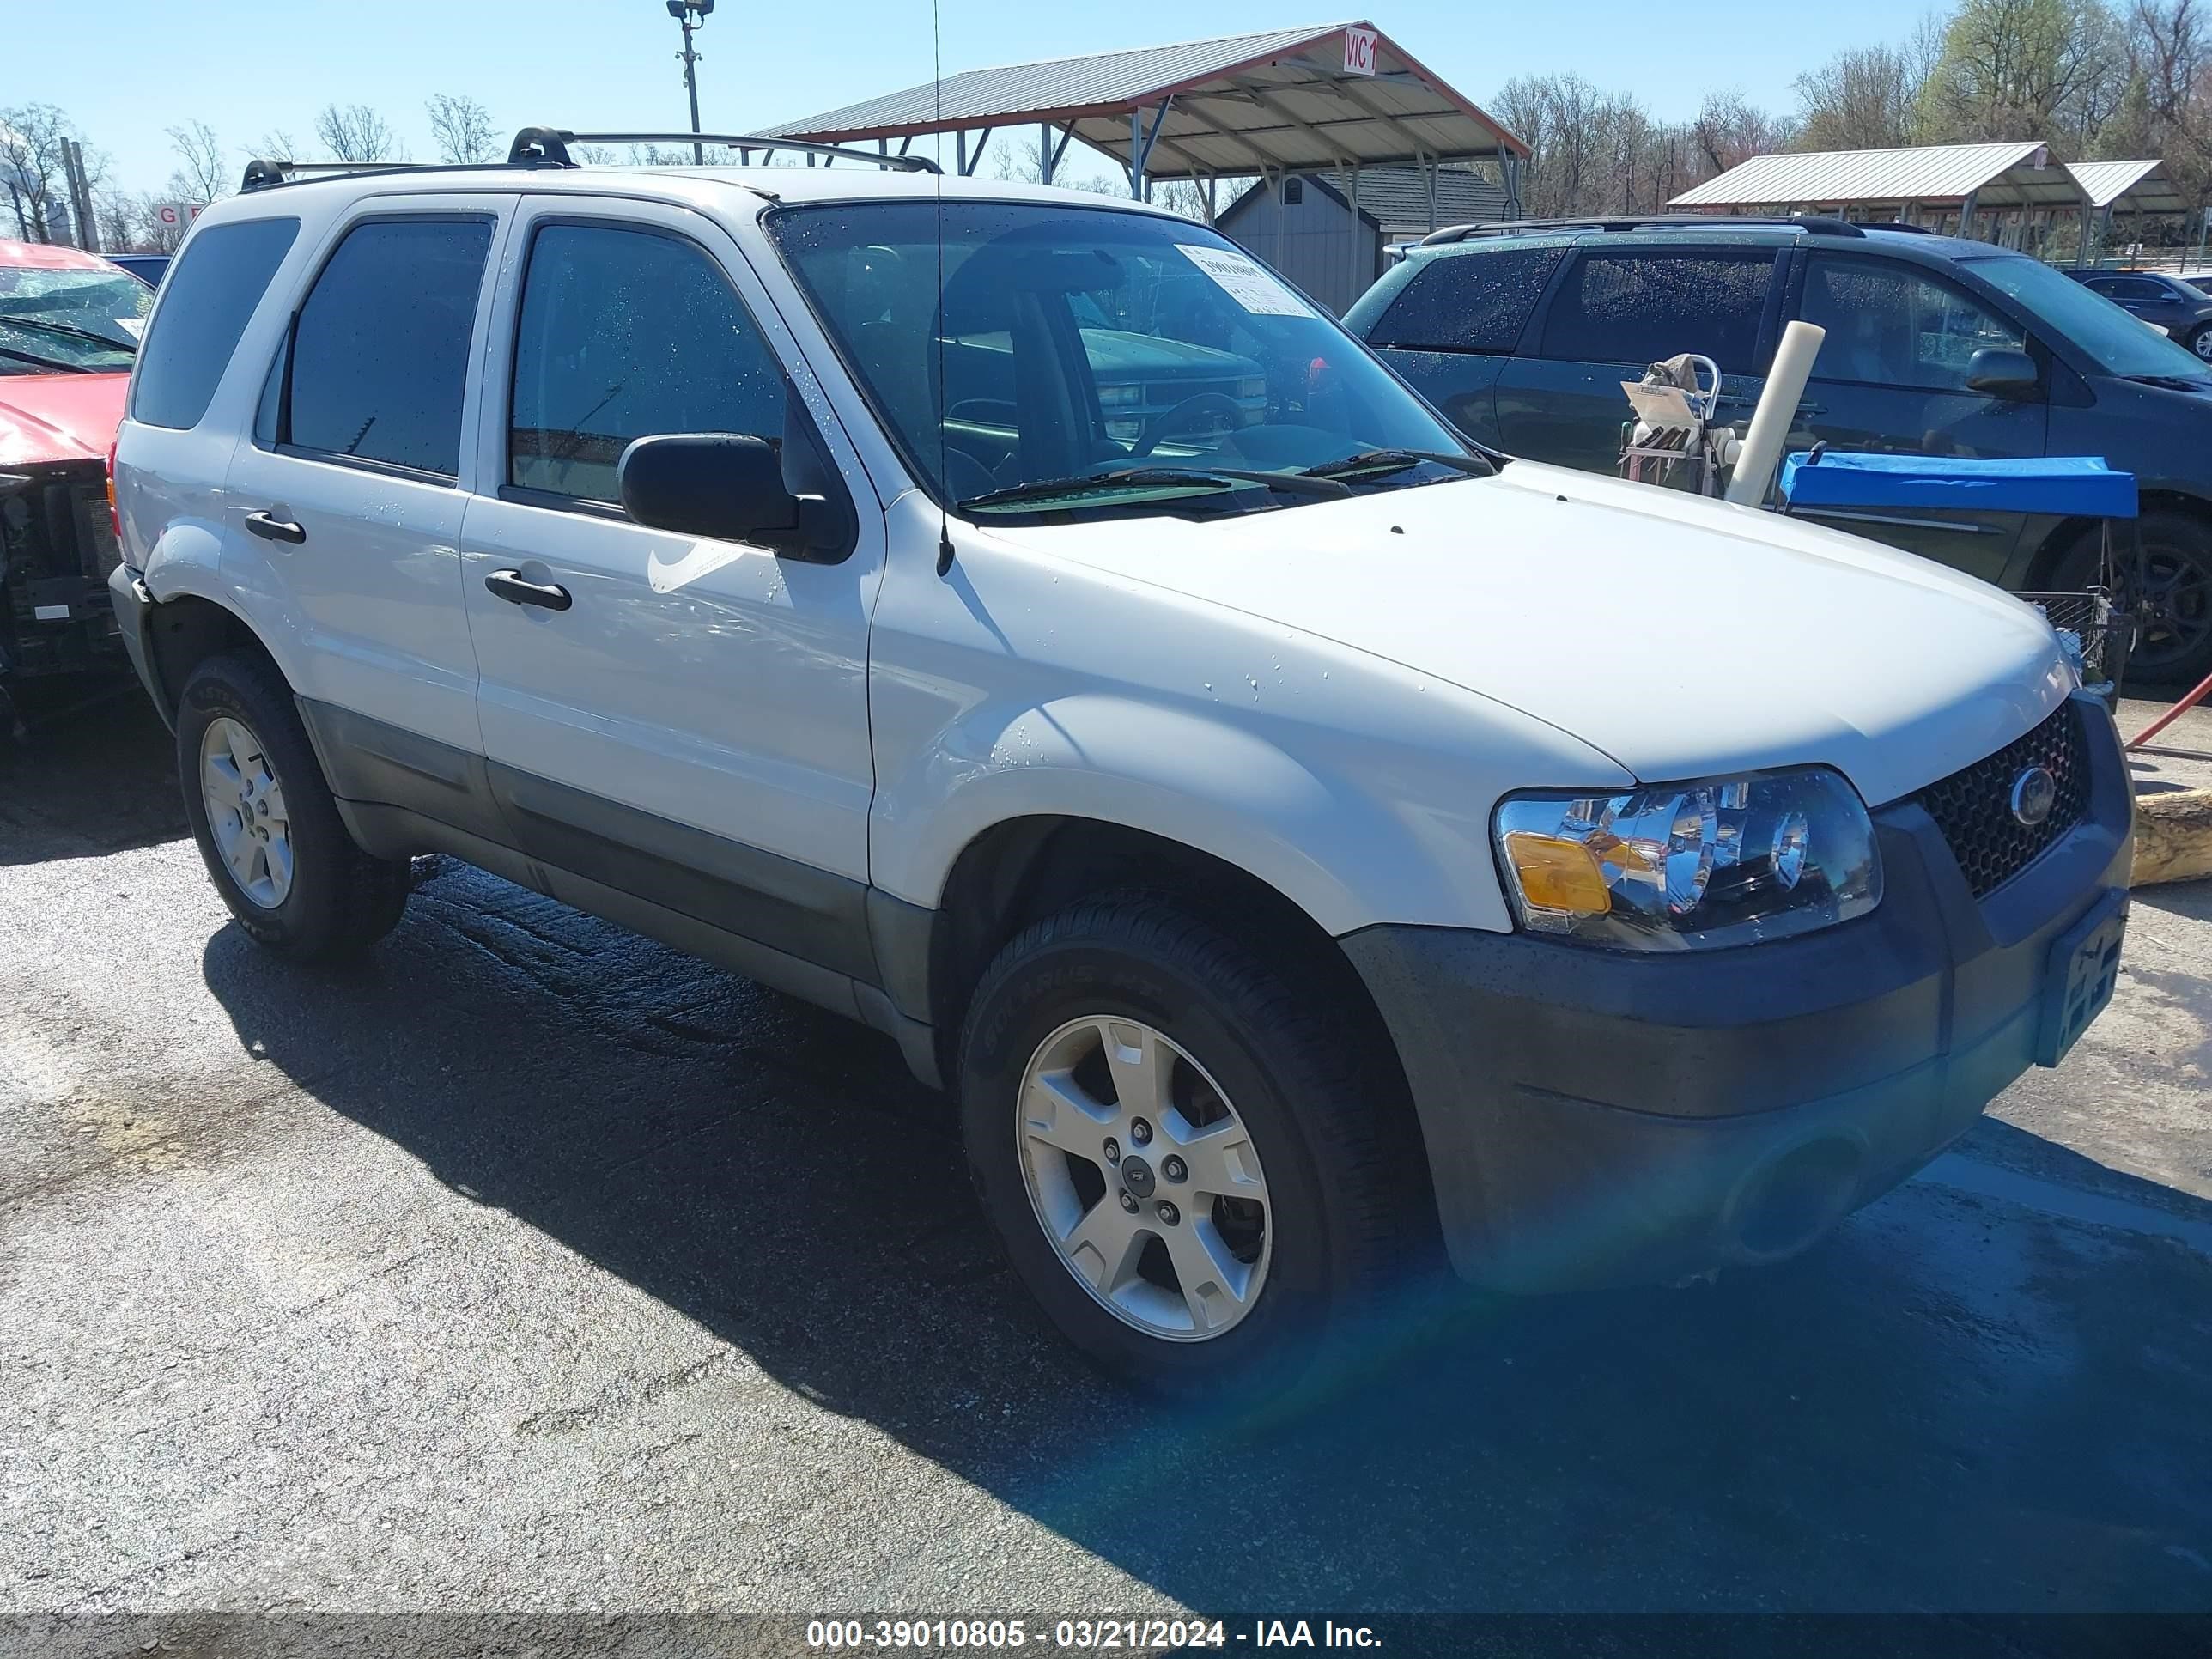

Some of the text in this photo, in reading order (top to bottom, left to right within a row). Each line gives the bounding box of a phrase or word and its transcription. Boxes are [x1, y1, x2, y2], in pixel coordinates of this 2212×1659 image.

[1346, 33, 1376, 70] VIC 1
[160, 208, 175, 223] G
